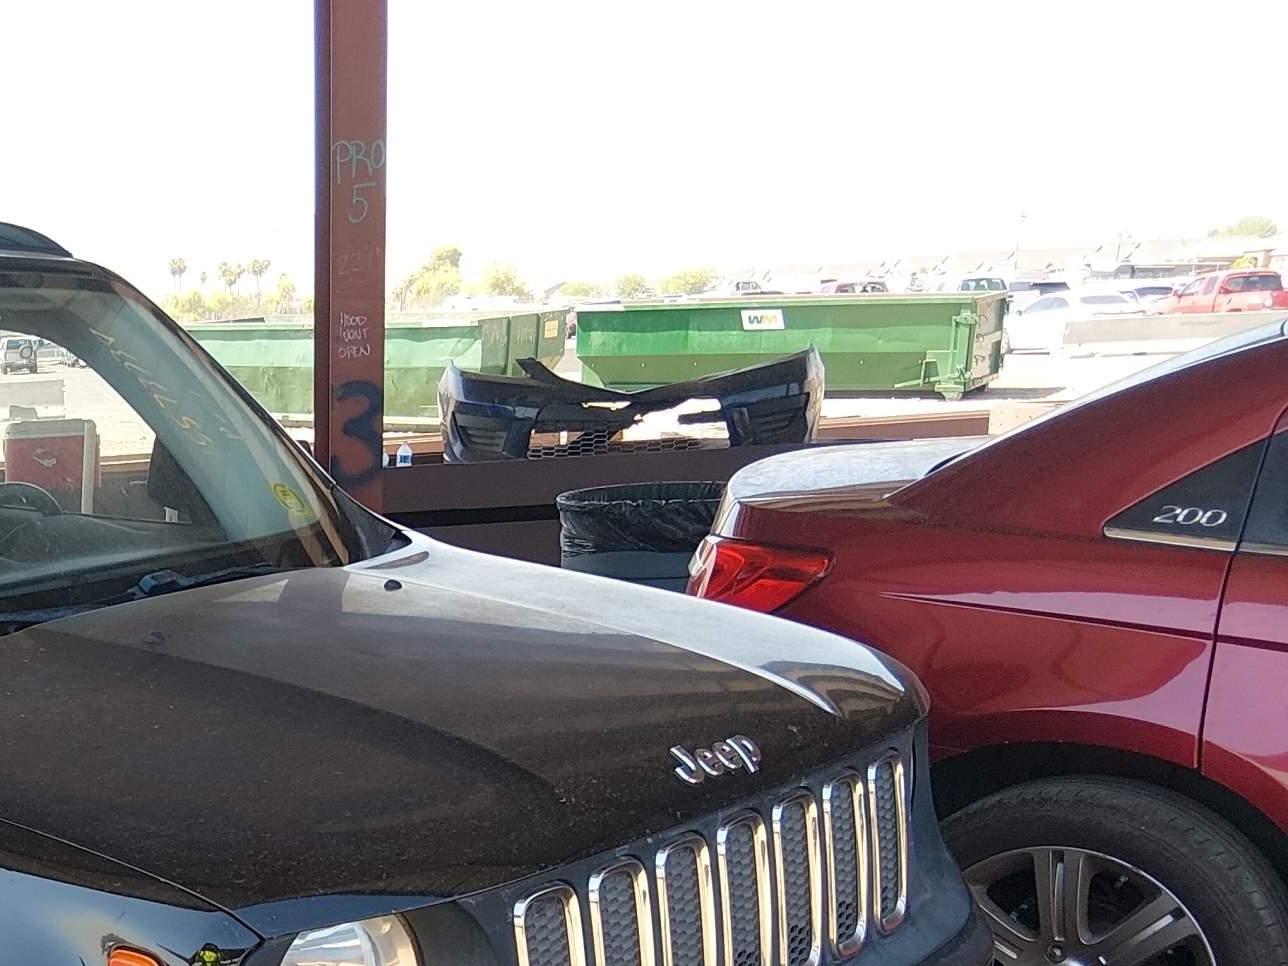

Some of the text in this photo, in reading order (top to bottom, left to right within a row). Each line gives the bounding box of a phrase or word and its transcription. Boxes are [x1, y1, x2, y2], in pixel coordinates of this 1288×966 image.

[332, 139, 385, 184] PRO
[347, 181, 377, 223] 5
[748, 315, 778, 325] WM
[1152, 504, 1228, 527] 200
[669, 734, 762, 784] Jeep
